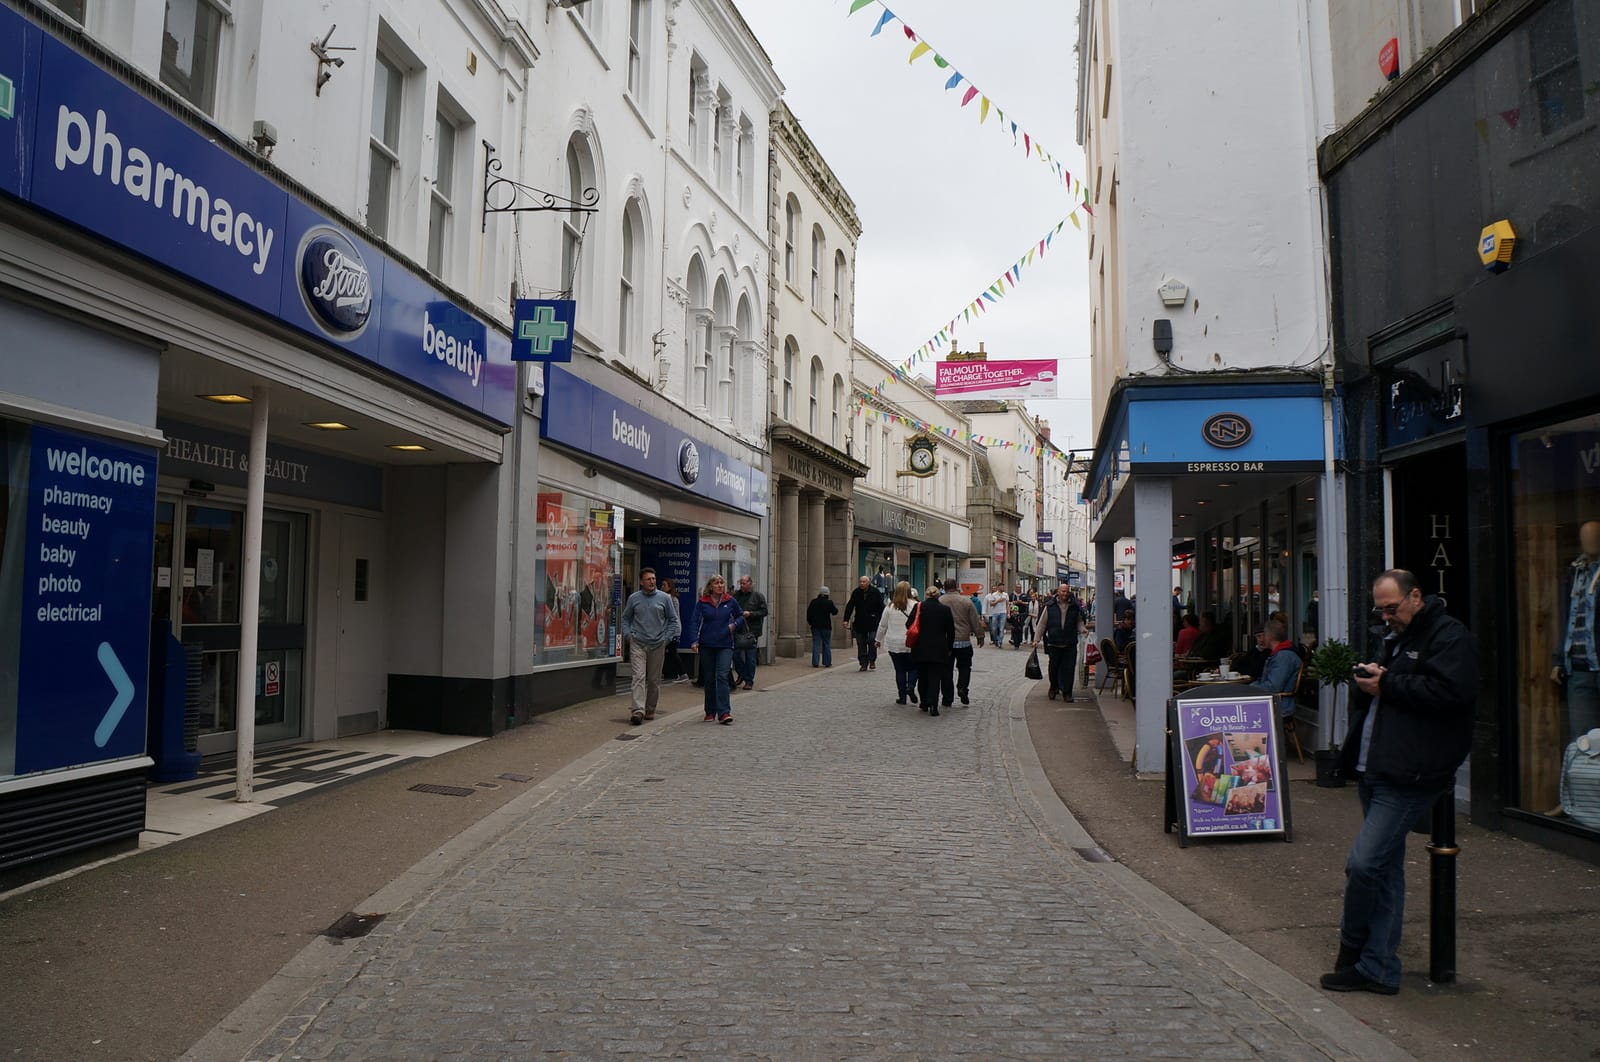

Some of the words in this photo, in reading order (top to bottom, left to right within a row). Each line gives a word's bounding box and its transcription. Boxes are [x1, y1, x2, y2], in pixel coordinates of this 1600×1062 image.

[55, 105, 273, 275] pharmacy
[313, 248, 371, 308] Boots
[423, 311, 483, 387] beauty
[939, 364, 989, 376] FALMOUTH.
[940, 376, 953, 384] WE
[953, 373, 983, 383] CHARGE
[612, 409, 650, 459] beauty
[47, 447, 145, 486] welcome
[165, 436, 236, 469] HEALTH
[239, 454, 249, 472] &
[264, 457, 308, 483] EAUTY
[1187, 463, 1240, 472] ESPRESSO
[1243, 462, 1264, 471] BAR
[715, 463, 746, 496] pharmacy
[787, 455, 810, 478] MARKS
[818, 471, 843, 492] SPENCER
[43, 485, 113, 514] pharmacy
[42, 513, 91, 540] beauty
[643, 535, 691, 545] welcome
[40, 543, 76, 568] baby
[668, 559, 691, 568] beauty
[1124, 546, 1136, 556] ph
[1431, 514, 1452, 608] HAI
[38, 573, 82, 595] photo
[37, 604, 102, 622] electrical
[1200, 704, 1248, 727] Janelli
